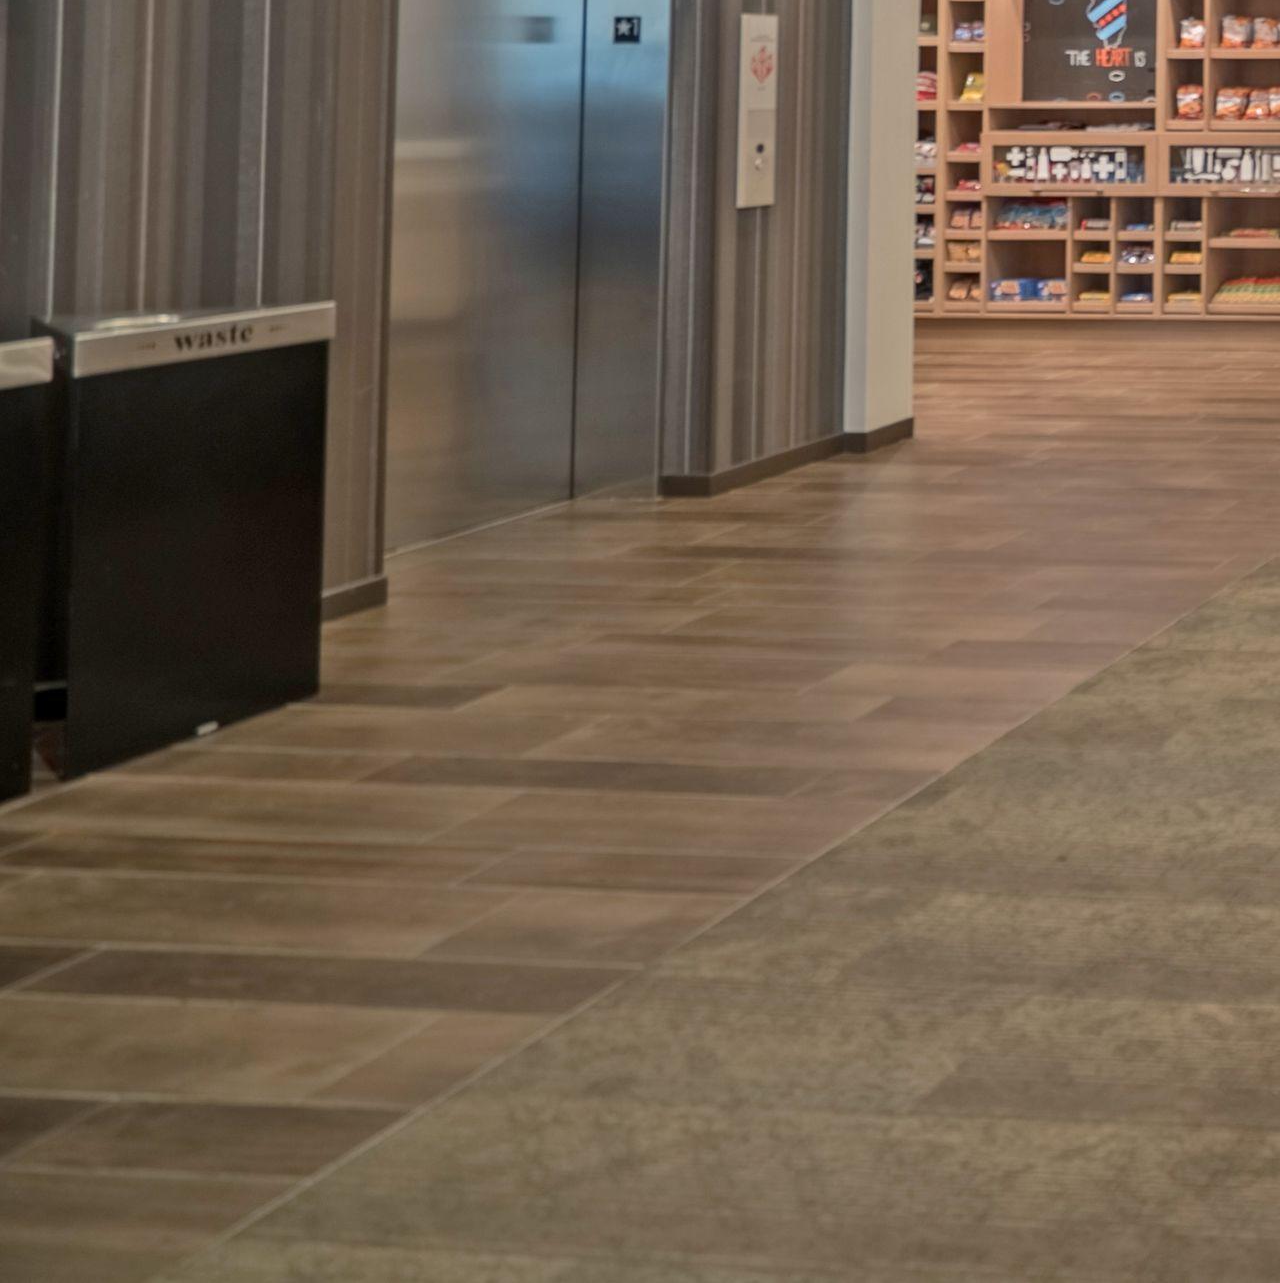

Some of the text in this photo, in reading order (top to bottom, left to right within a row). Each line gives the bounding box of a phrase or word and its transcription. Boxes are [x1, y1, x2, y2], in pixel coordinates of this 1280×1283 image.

[1065, 48, 1147, 68] THE HEART IS
[174, 324, 254, 351] waste
